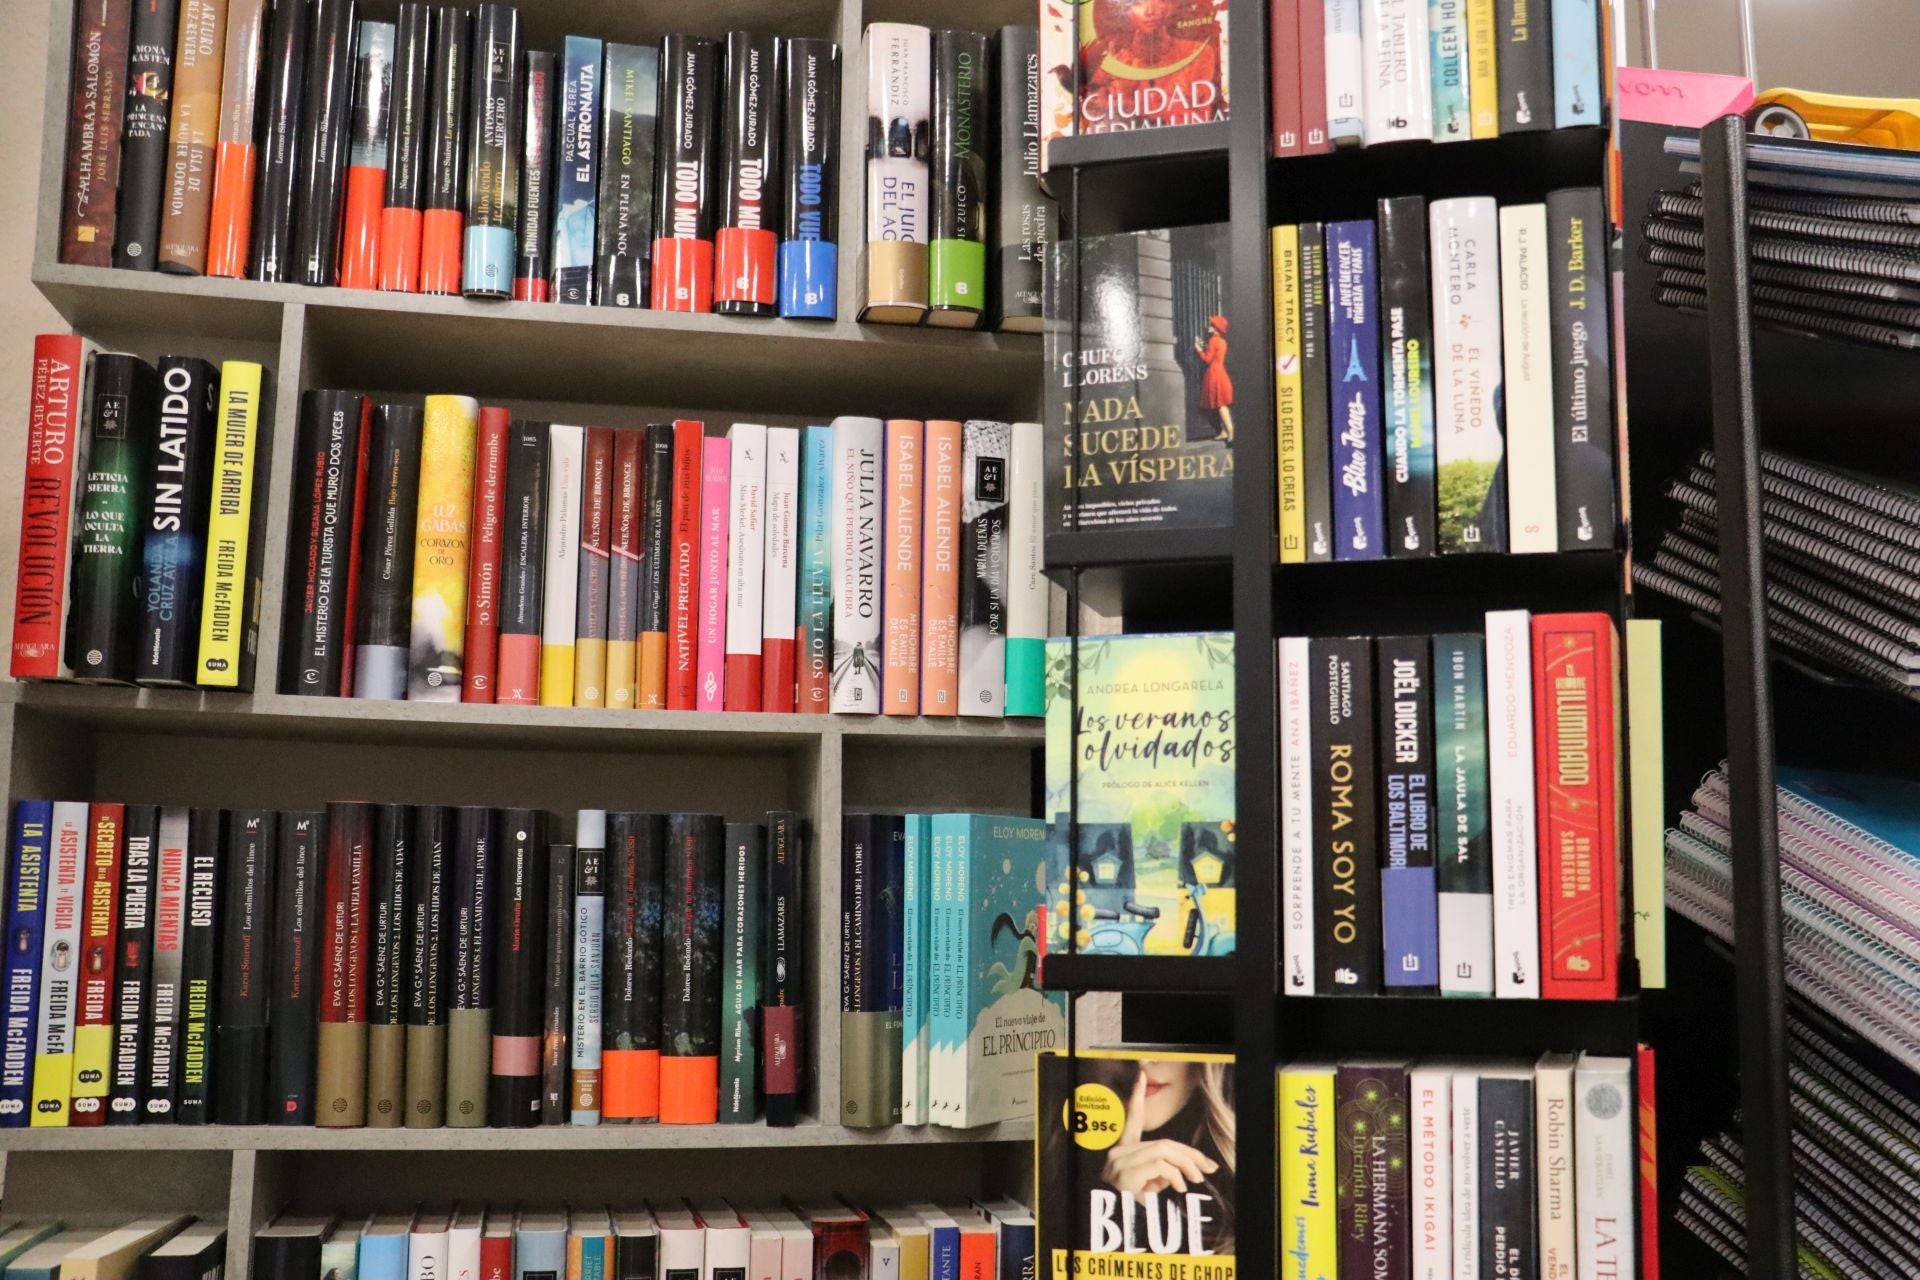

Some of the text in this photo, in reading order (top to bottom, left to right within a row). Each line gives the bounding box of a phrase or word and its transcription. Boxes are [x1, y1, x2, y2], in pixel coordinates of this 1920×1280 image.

[1177, 18, 1212, 30] SANGRE
[1441, 25, 1459, 86] COLLEEN
[1511, 27, 1528, 42] La
[566, 80, 577, 162] PASCUAL PEREA
[577, 64, 594, 182] EL ASTRONAUTA
[684, 52, 697, 149] JUAN GÓMEZ-JURADO
[1023, 53, 1039, 178] Julio Llamazares
[1082, 80, 1216, 122] CIUDAD
[528, 170, 540, 208] FUENTES
[675, 161, 698, 202] TODO
[956, 185, 967, 223] ZUECO
[526, 210, 539, 252] TRINIDAD
[1018, 204, 1032, 261] Las rosas
[1463, 239, 1477, 291] CARLA
[1283, 249, 1295, 344] BRIAN TRACY
[30, 358, 49, 465] PÉREZ-REVERTE
[43, 358, 71, 465] ARTURO
[1390, 306, 1409, 483] CUANDO LA TORMENTA PASE
[1567, 322, 1589, 443] El último juego
[153, 367, 192, 532] SIN LATIDO
[219, 391, 248, 515] LA MUJER DE ARRIBA
[594, 458, 603, 495] BRONCE
[1109, 453, 1234, 485] VÍSPERA
[1340, 392, 1367, 496] Blue Jeans
[482, 433, 499, 543] Peligro de derrumbe
[593, 497, 602, 511] DE
[897, 435, 914, 571] ISABEL ALLENDE
[20, 478, 61, 625] REVOLUCIÓN
[314, 410, 344, 656] EL MISTERIO DE LA TURISTA QUE MURIÓ DOS VECES
[429, 556, 454, 565] ORO
[590, 512, 602, 548] SUEÑOS
[858, 448, 874, 618] JULIA NAVARRO
[147, 543, 163, 613] YOLANDA
[475, 562, 493, 608] Simón
[707, 508, 720, 644] UN HOGAR JUNTO AL MAR
[889, 618, 898, 667] DEL VALLE
[909, 613, 918, 673] MI NOMBRE
[1086, 680, 1225, 695] ANDREA LONGARELA
[1115, 707, 1236, 732] veranos
[1341, 661, 1351, 717] SANTIAGO
[1393, 659, 1420, 762] JOËL DICKER
[1084, 729, 1236, 772] olvidados
[1102, 780, 1140, 789] PRÓLOGO
[1142, 781, 1152, 789] DE
[1154, 780, 1177, 788] ALICE
[1388, 773, 1406, 798] LOS
[778, 819, 786, 865] ALFAGUARA
[1329, 744, 1356, 944] ROMA SOY YO
[1408, 773, 1428, 850] EL LIBRO DE
[17, 822, 44, 912] LA ASISTENTA
[55, 829, 78, 930] ASISTENTA VIGILA
[90, 822, 115, 936] SECRETO ASISTENTA
[123, 836, 150, 929] TRAS LA PUERTA
[158, 848, 183, 951] NUNCA MIENTAS
[190, 856, 214, 926] EL RECLUSO
[240, 843, 256, 997] Karin Los colmillos del lince
[333, 901, 345, 1007] EVA SÁENZ DE URTURI
[390, 840, 405, 1014] LOS LONGEVOS LOS HIJOS DE ADÁN
[777, 896, 786, 951] LLAMAZARES
[49, 980, 69, 1021] FREIDA
[624, 937, 634, 1001] Dolores Redondo
[5, 969, 33, 1085] FREIDA McFADDEN
[982, 1036, 998, 1057] EL
[732, 1077, 742, 1113] NdeNovela
[1423, 1089, 1436, 1251] EL MÉTODO IKIGAI
[1508, 1130, 1520, 1180] JAVIER
[1547, 1098, 1565, 1220] Robin Sharma
[1090, 1189, 1215, 1257] BLUE
[1371, 1135, 1387, 1246] LA HERMANA
[1594, 1217, 1617, 1245] LA
[1088, 1255, 1162, 1280] CRÍMENES
[1170, 1263, 1186, 1280] DE
